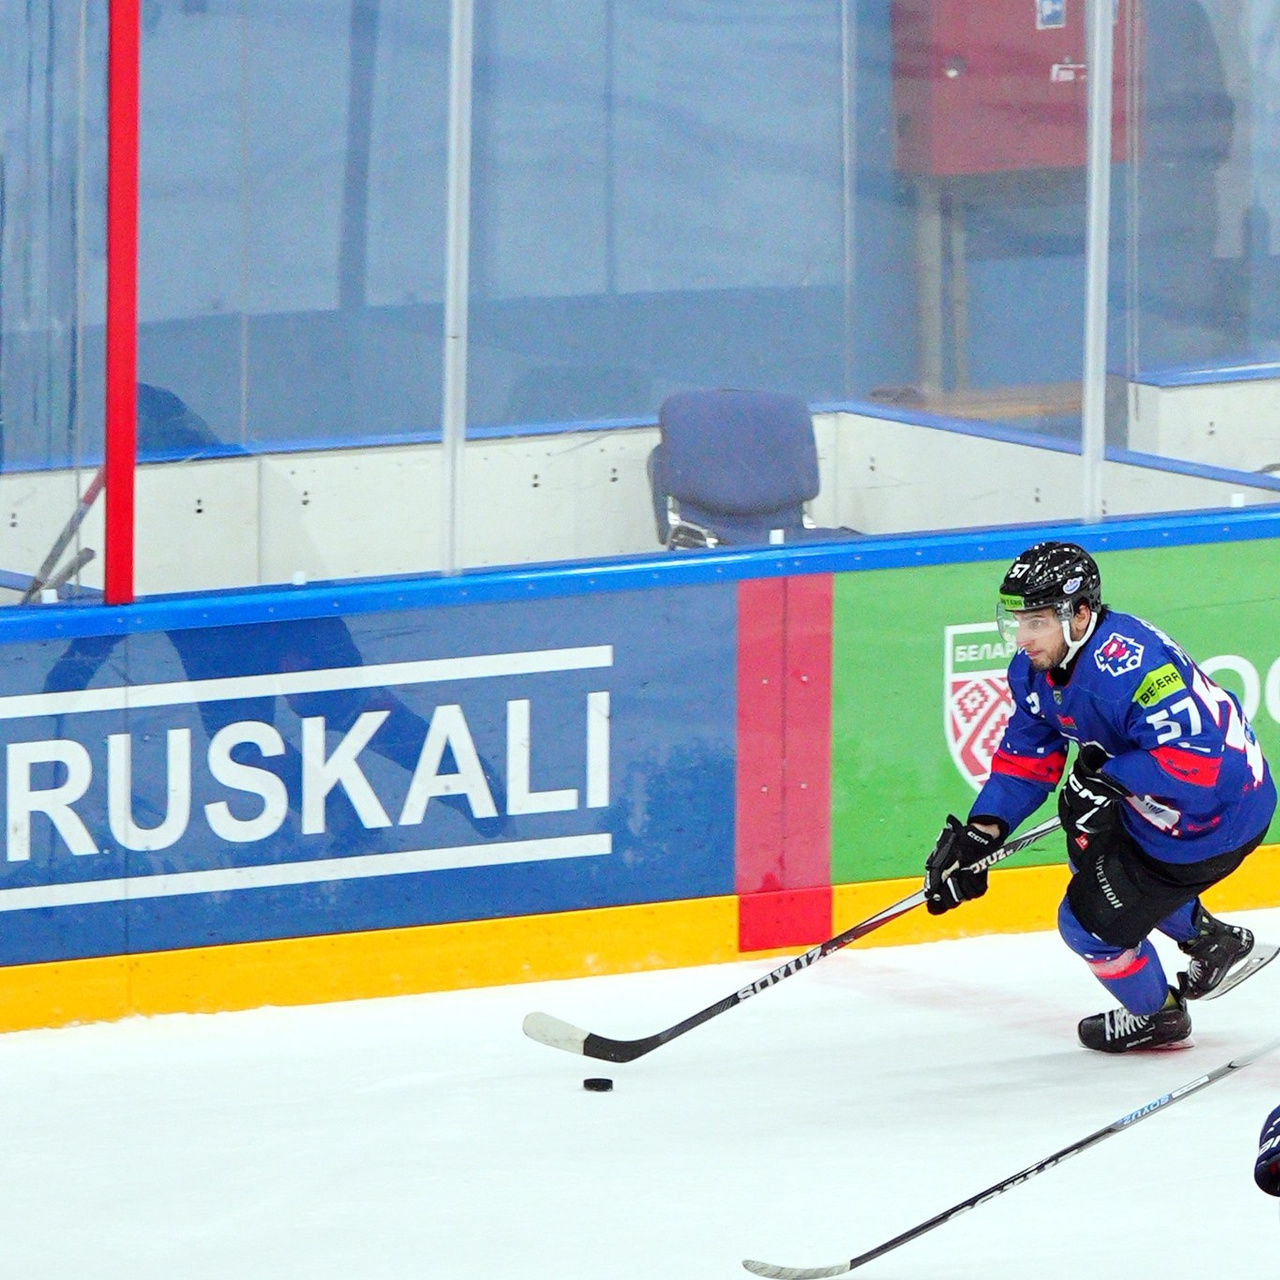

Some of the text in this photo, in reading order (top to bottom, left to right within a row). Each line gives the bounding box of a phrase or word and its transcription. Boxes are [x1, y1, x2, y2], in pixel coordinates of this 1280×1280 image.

[1009, 564, 1030, 578] 57
[955, 643, 1014, 662] БЕЛАР
[1146, 696, 1202, 745] 57
[6, 691, 609, 861] RUSKALI
[972, 848, 1006, 875] OYUZ
